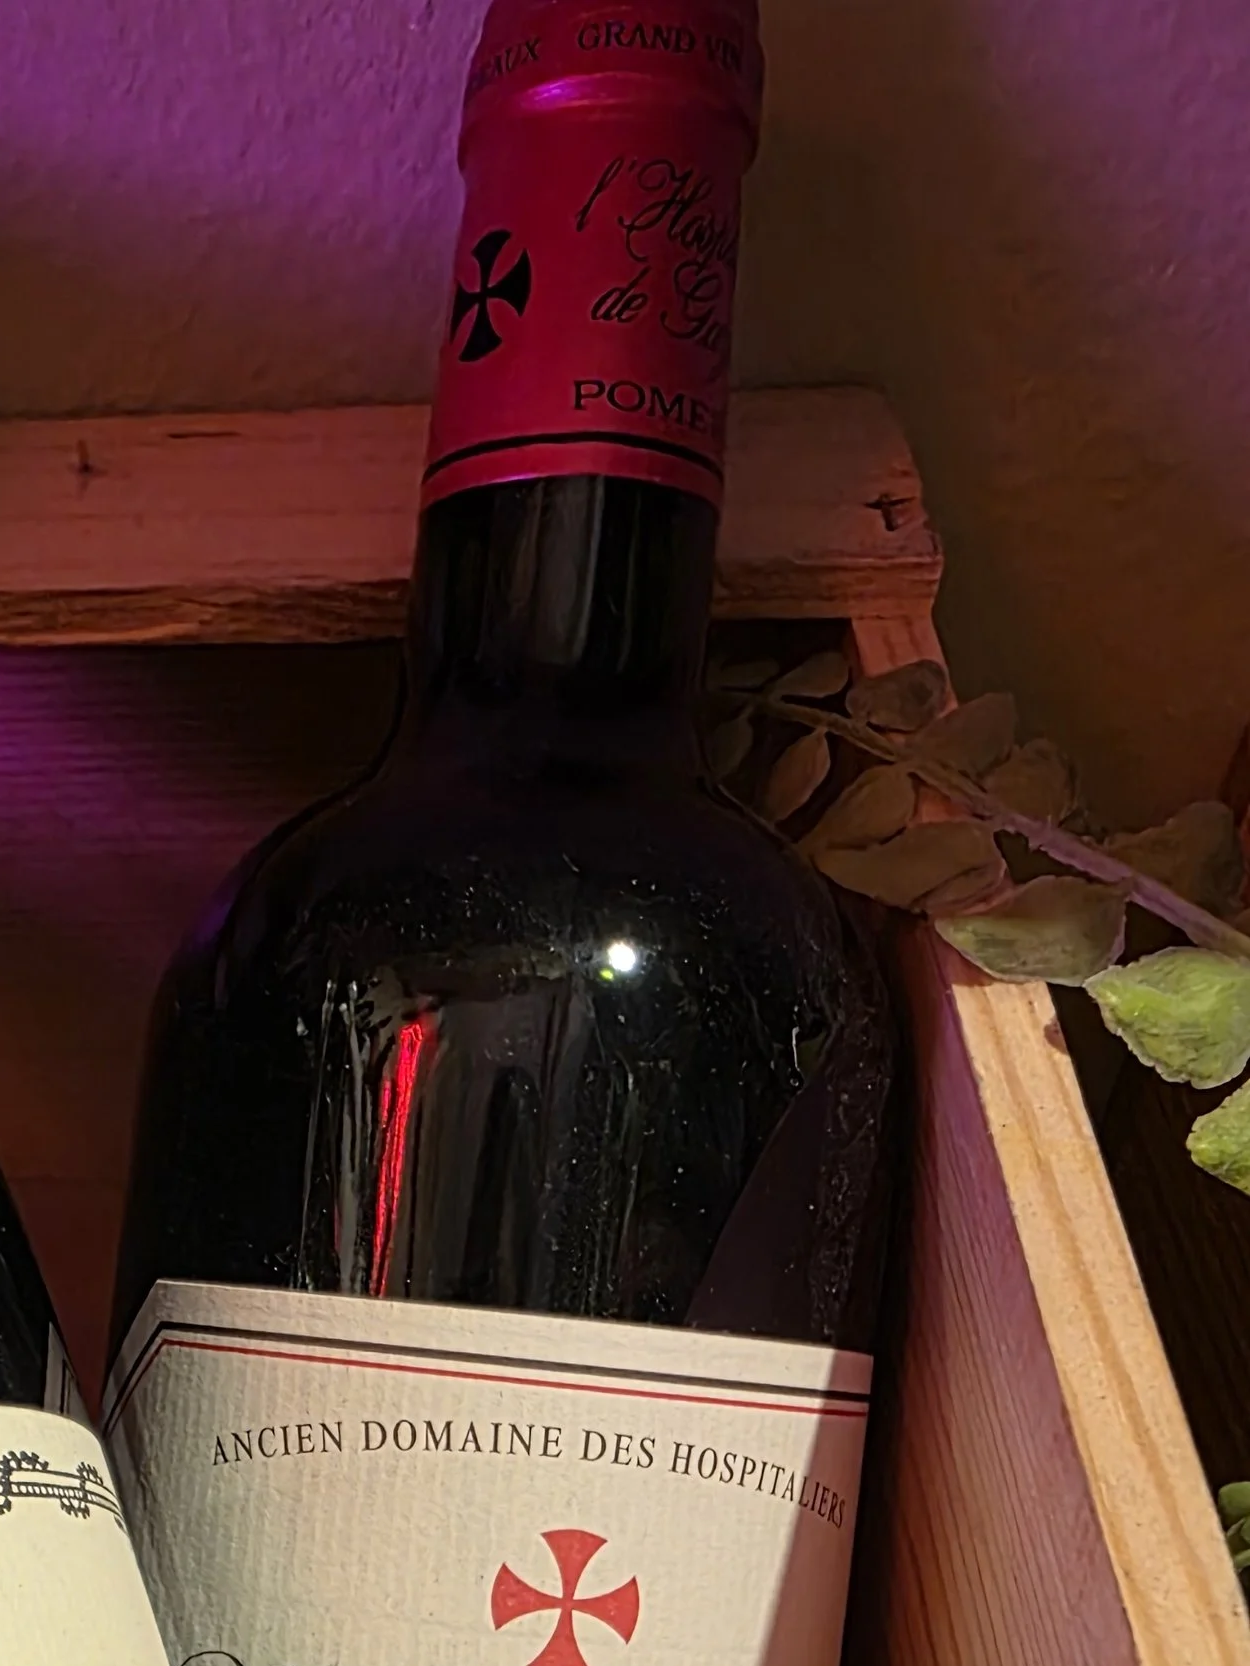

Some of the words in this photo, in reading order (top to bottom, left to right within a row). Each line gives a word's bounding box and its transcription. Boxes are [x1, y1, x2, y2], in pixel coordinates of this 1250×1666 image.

[577, 20, 697, 54] GRAND
[590, 265, 652, 323] de
[211, 1421, 345, 1467] ANCIEN
[360, 1418, 563, 1460] DOMAINE
[579, 1427, 658, 1469] DES
[669, 1440, 846, 1530] HOSPITALIERS
